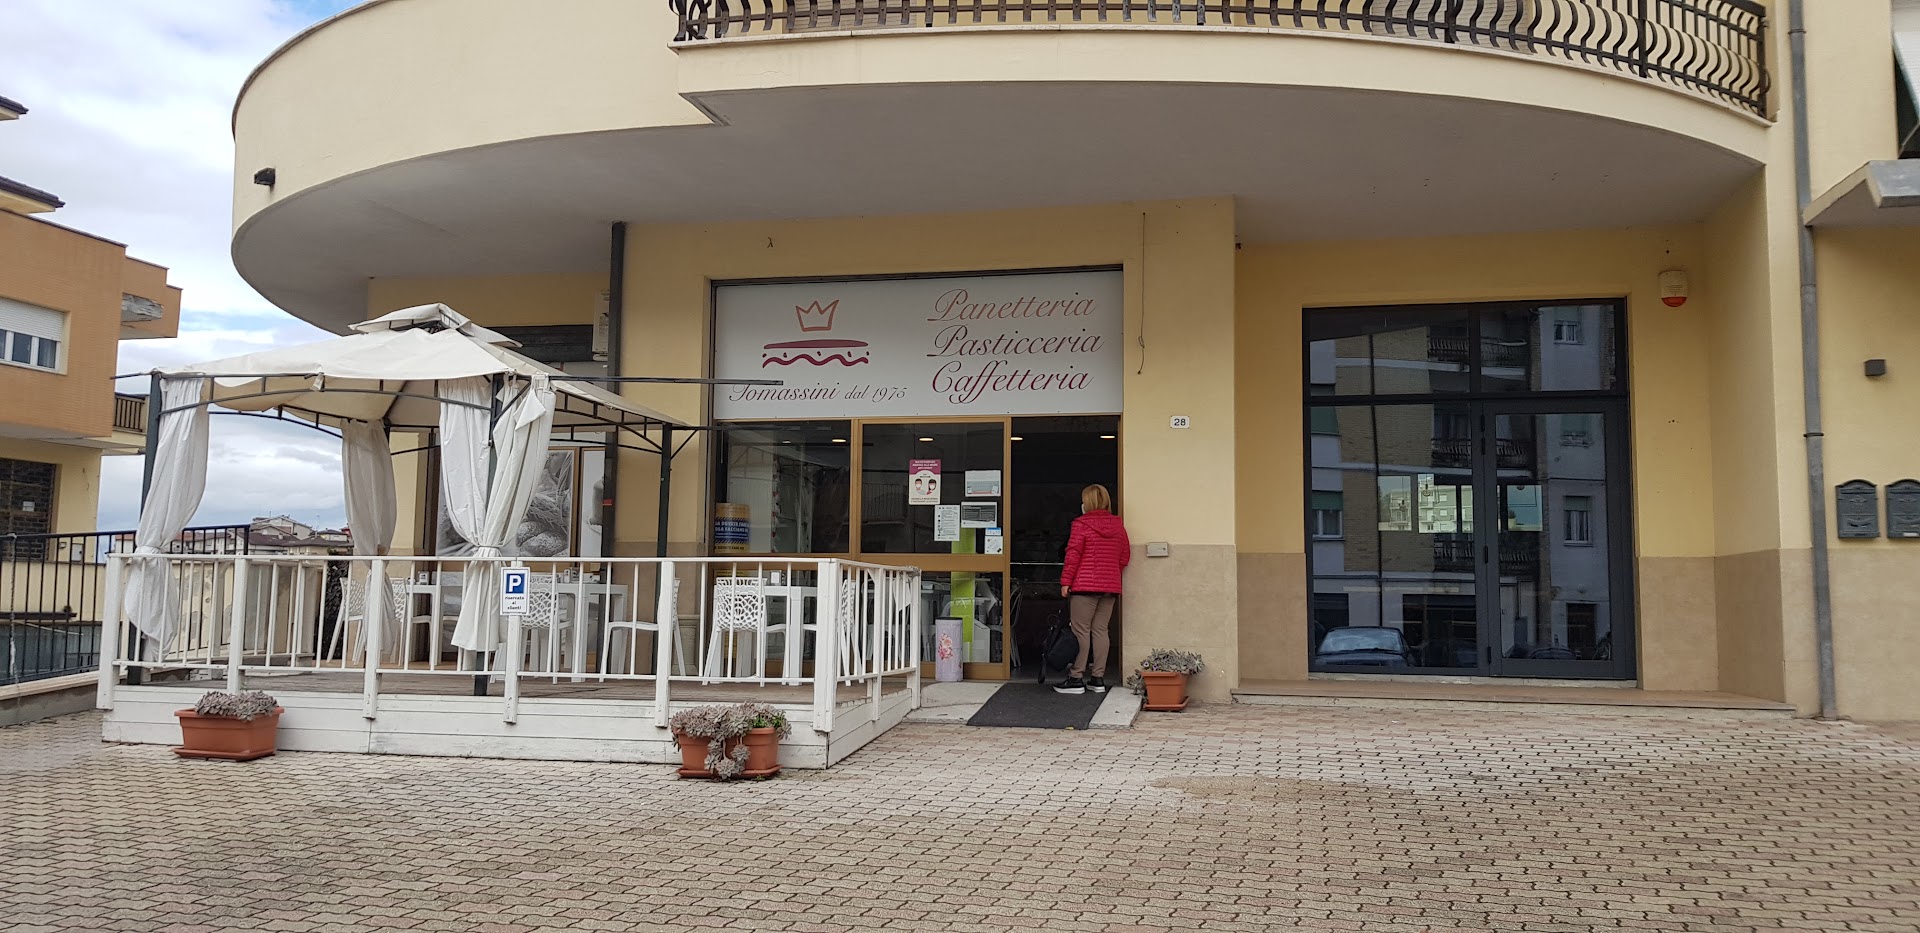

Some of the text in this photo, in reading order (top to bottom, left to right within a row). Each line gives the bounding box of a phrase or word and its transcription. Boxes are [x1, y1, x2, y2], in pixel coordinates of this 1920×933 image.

[927, 288, 1096, 321] Panetteria
[927, 324, 1104, 357] Pasticceria
[728, 382, 907, 403] Tomassini dal 1975
[932, 360, 1094, 404] Caffetteria
[1174, 418, 1186, 426] 28
[508, 575, 522, 592] P
